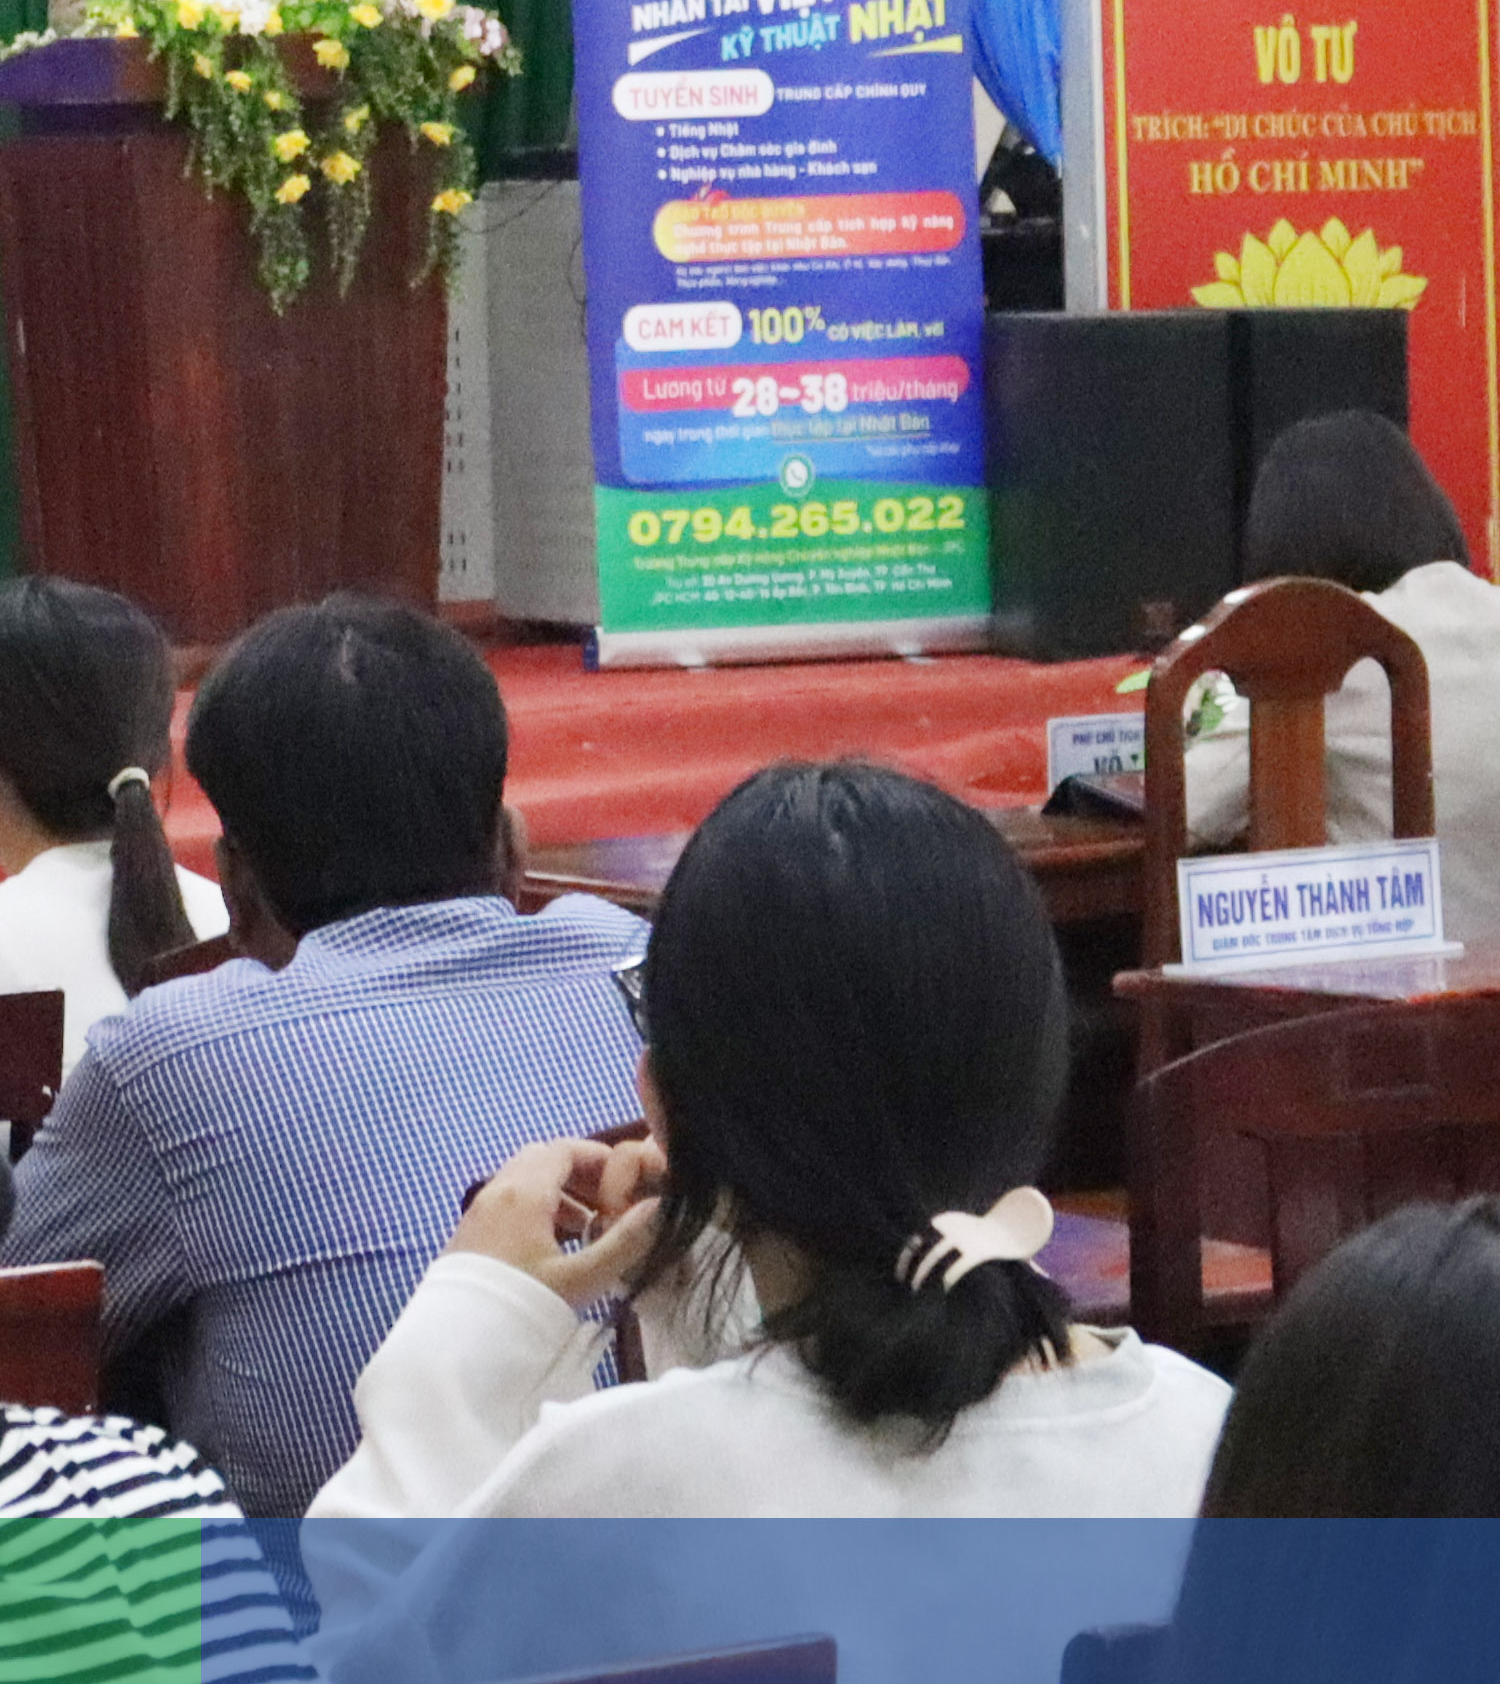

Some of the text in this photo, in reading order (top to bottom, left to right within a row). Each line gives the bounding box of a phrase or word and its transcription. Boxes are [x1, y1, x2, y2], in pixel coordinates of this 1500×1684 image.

[760, 14, 842, 53] THUẬT
[1253, 14, 1358, 84] VÔ TƯ
[630, 74, 704, 109] TUYỂN
[709, 84, 760, 108] SINH
[776, 86, 822, 102] TRUNG
[1423, 109, 1477, 140] TỊCH
[1247, 151, 1310, 193] CHÍ
[689, 309, 732, 338] KẾT
[748, 305, 827, 344] 100%
[643, 377, 703, 404] Lương
[627, 495, 967, 547] 0794.265.022
[1196, 865, 1426, 929] NGUYỄN THÀNH TÂM
